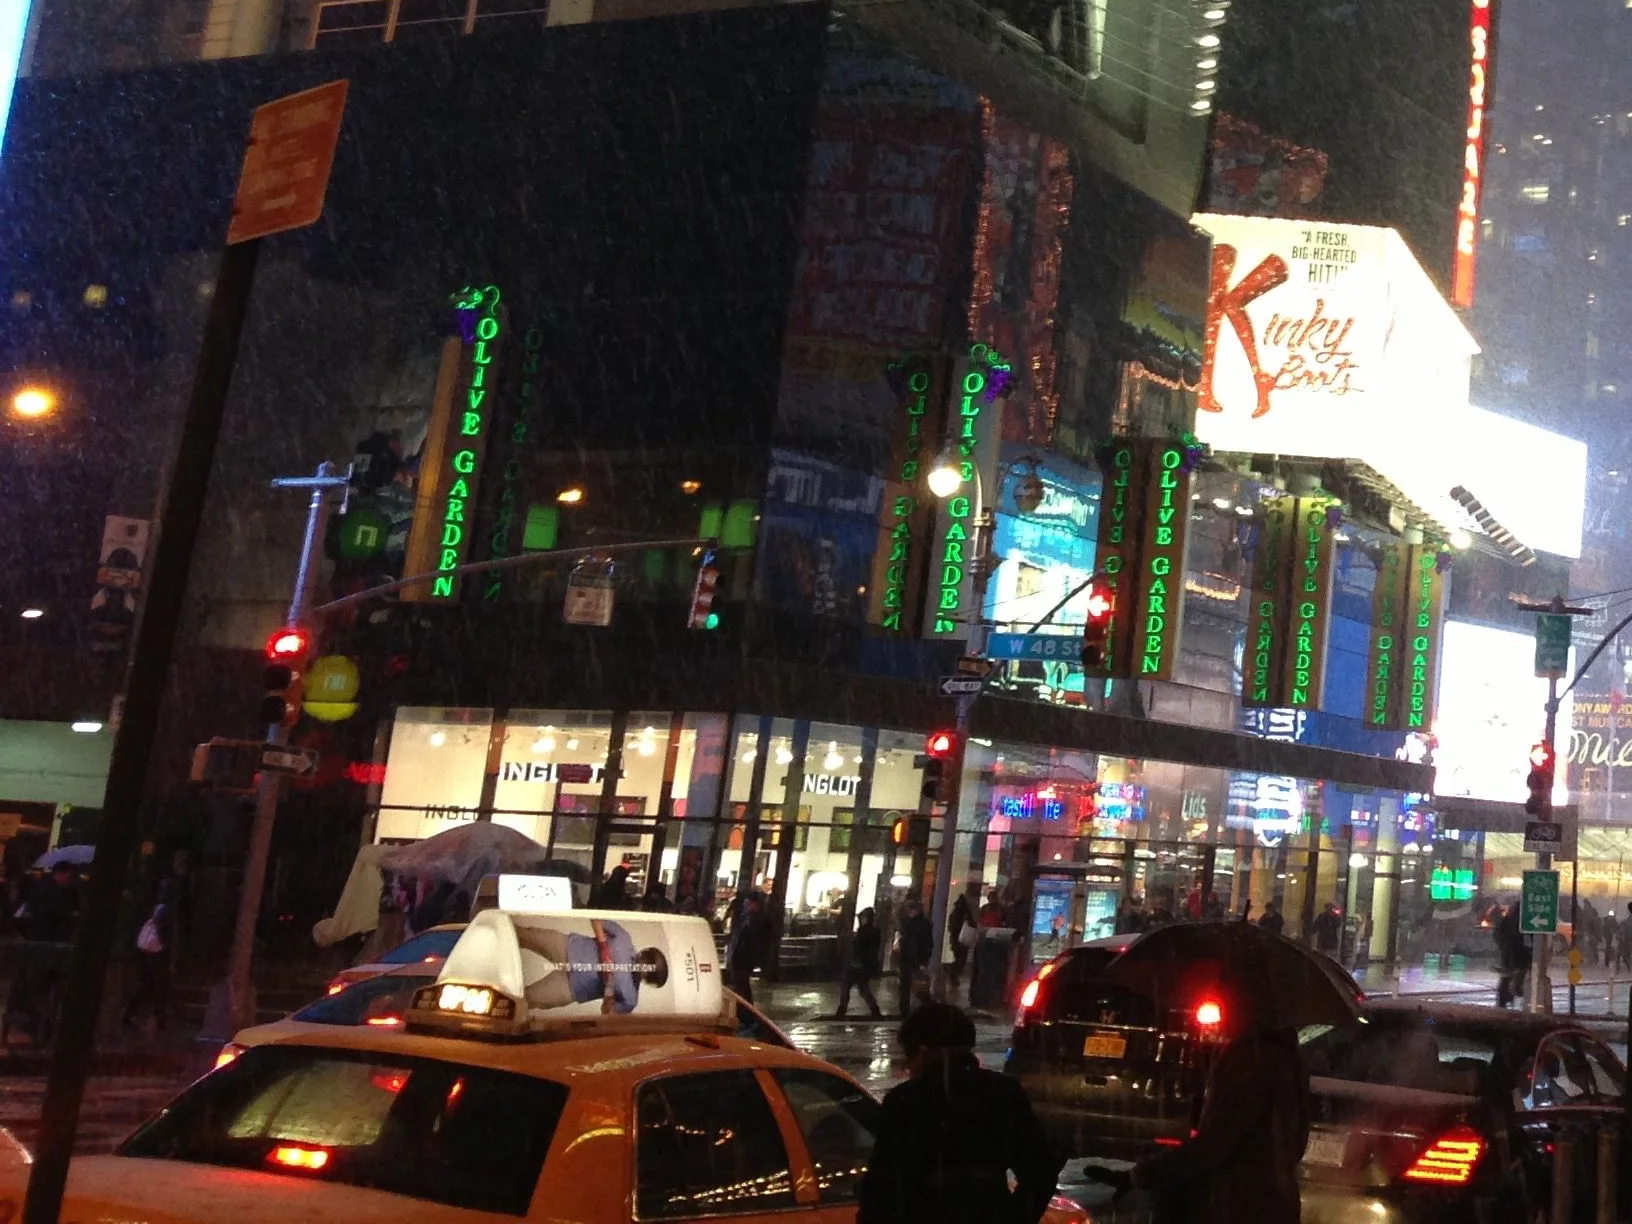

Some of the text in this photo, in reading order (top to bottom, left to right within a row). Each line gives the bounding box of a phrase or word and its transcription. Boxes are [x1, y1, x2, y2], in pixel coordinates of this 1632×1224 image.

[1291, 246, 1357, 264] BIG-HEARTED
[432, 317, 499, 597] OLIVE GARDEN
[934, 372, 985, 633] OLIVE GARDEN
[1141, 450, 1181, 674] OLIVE GARDEN
[1291, 510, 1325, 704] OLIVE GARDEN
[1008, 639, 1082, 656] W 48 St
[1408, 553, 1437, 726] OLIVE GARDEN
[1571, 703, 1593, 715] ONY
[803, 774, 861, 797] NGLOT
[1528, 893, 1552, 904] East
[1528, 903, 1552, 915] Side
[573, 962, 594, 973] YOUR
[595, 962, 657, 974] INTERPRETATION?
